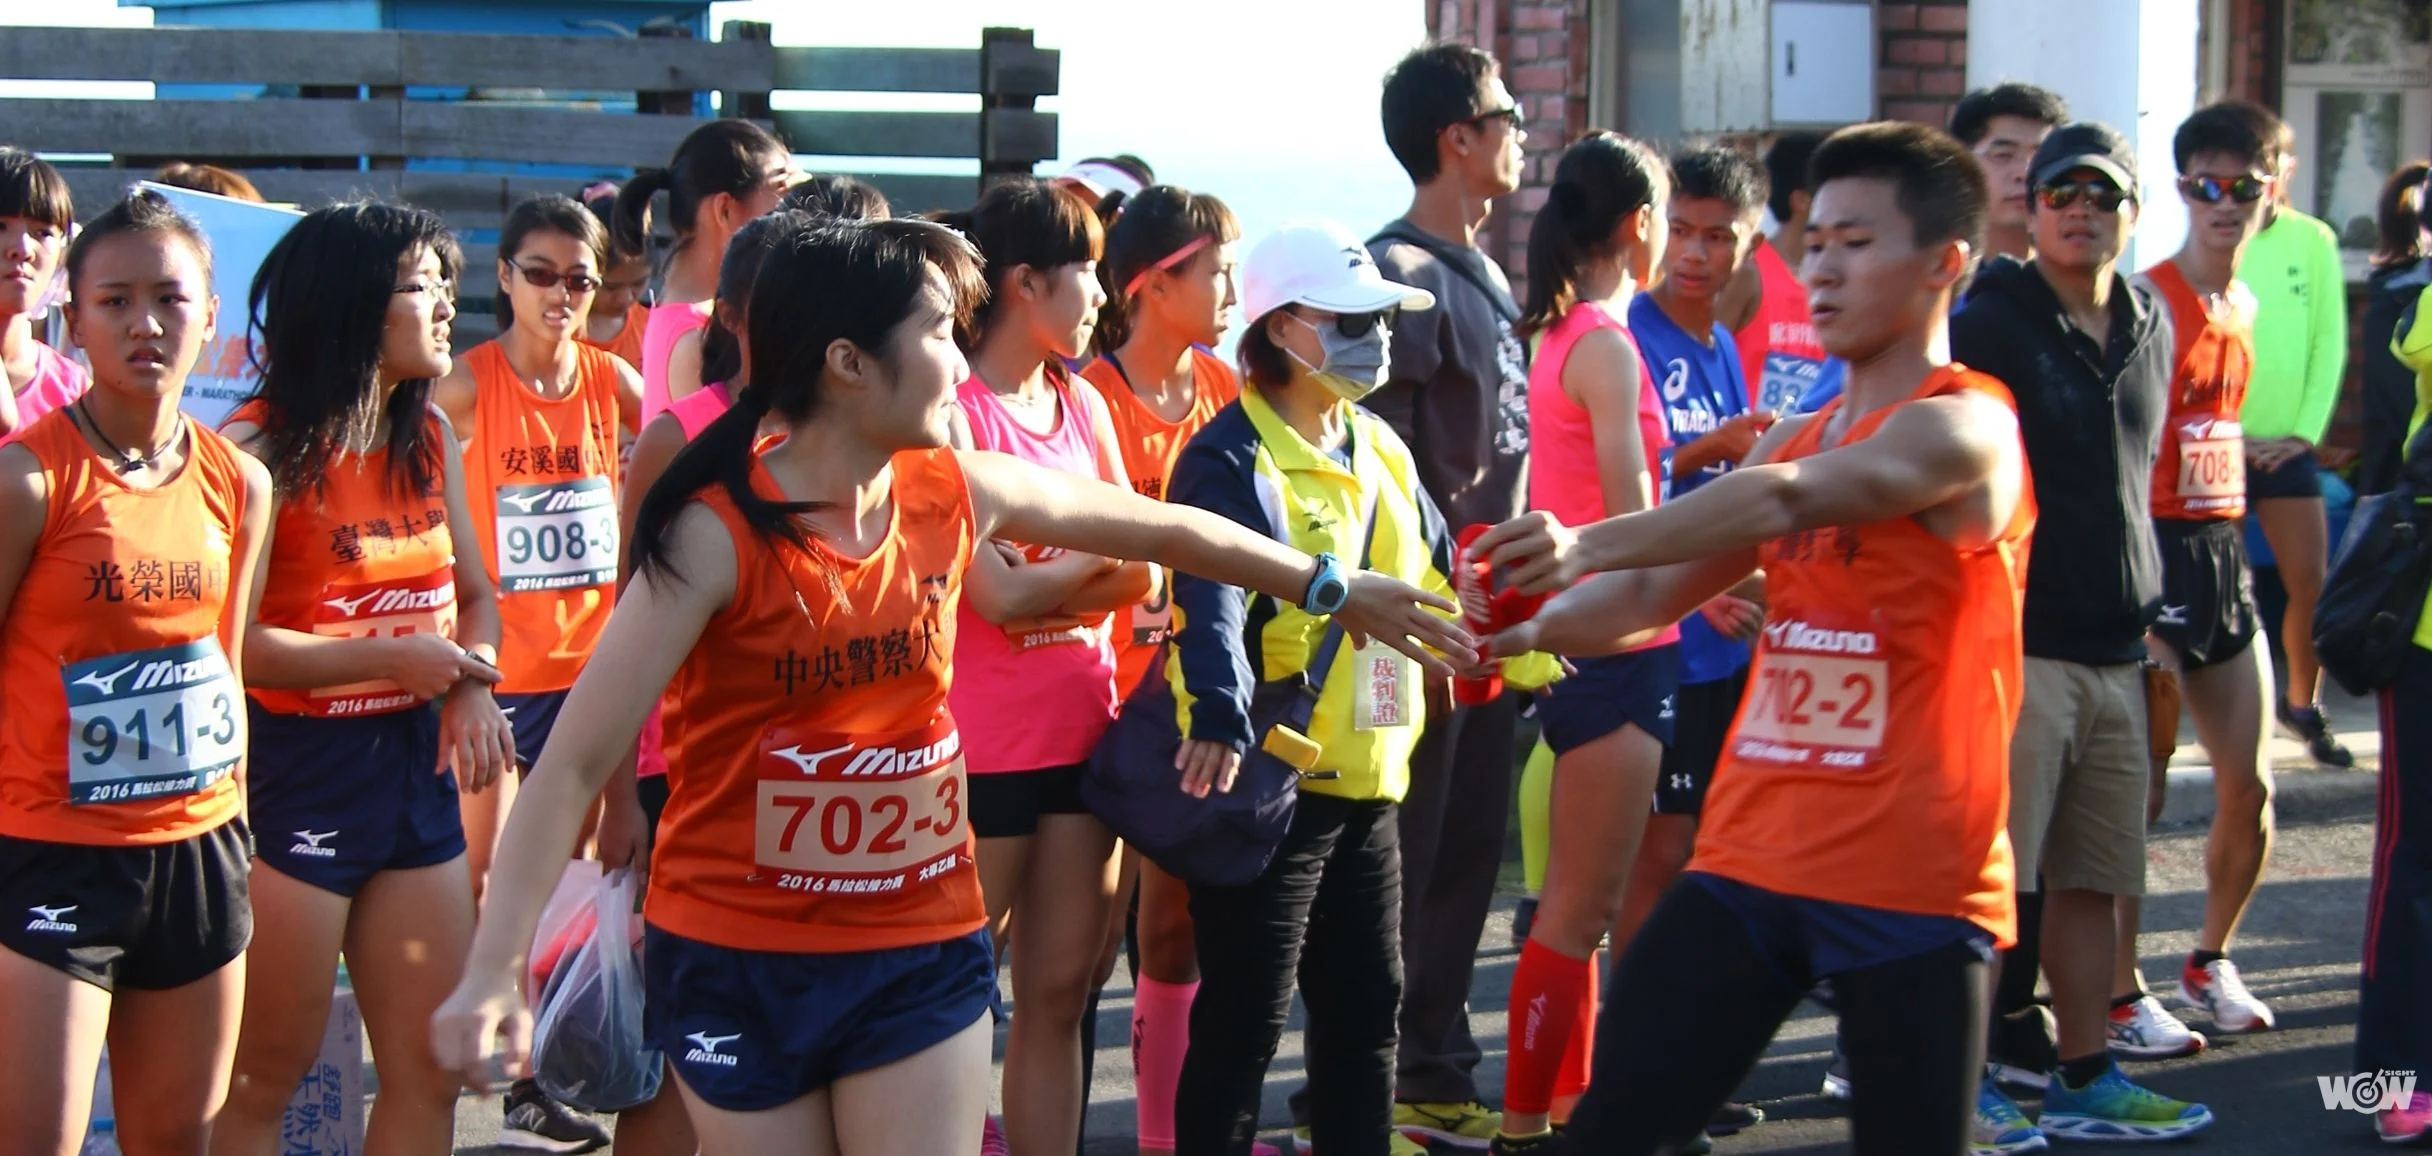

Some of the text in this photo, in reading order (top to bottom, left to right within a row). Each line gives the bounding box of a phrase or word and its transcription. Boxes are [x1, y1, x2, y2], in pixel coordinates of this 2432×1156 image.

[507, 518, 614, 565] 908-3
[84, 560, 227, 603] 光榮國中
[513, 577, 544, 591] 2016
[1023, 633, 1050, 648] 2016
[1372, 656, 1397, 724] 裁判證
[327, 699, 363, 714] 2016
[82, 692, 235, 766] 911-3
[89, 783, 130, 800] 2016
[772, 776, 961, 855] 702-3
[777, 873, 826, 892] 2016
